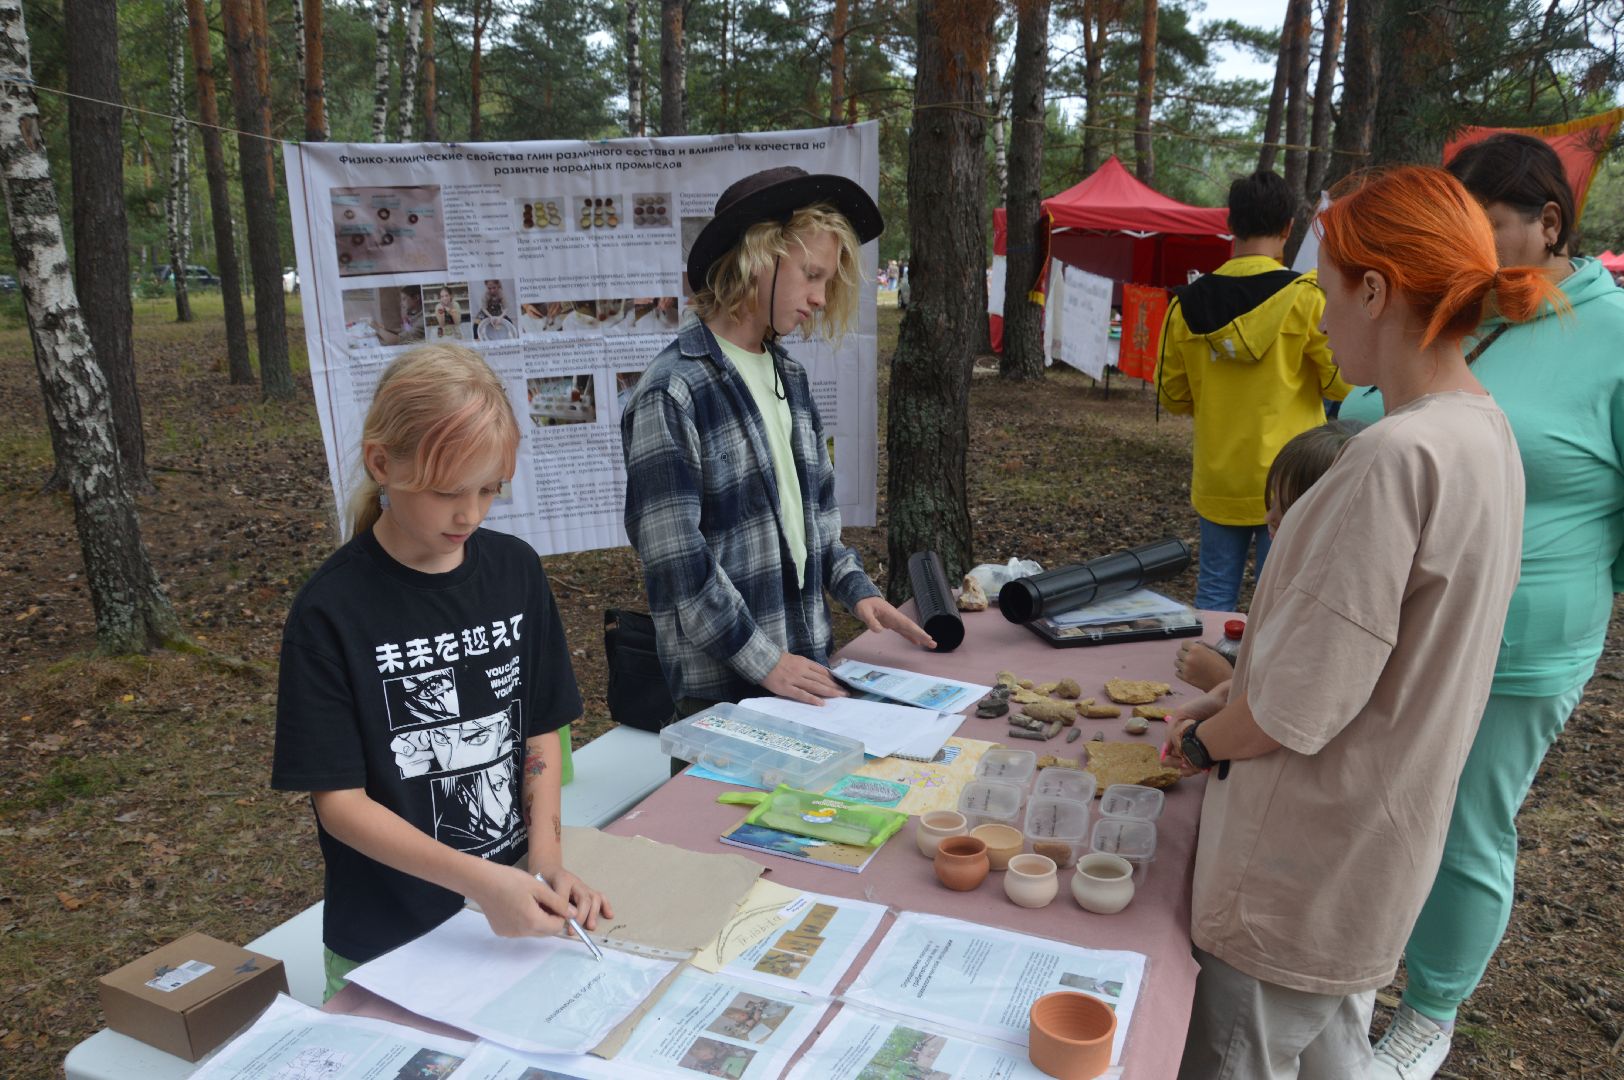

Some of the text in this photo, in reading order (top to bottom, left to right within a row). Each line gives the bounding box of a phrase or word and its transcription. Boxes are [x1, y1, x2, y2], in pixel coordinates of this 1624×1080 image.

[338, 151, 464, 165] Физико-химические
[466, 150, 524, 161] свойства
[526, 151, 553, 161] глин
[556, 147, 622, 161] различного
[625, 147, 675, 157] состава
[688, 143, 735, 155] влияние
[737, 142, 751, 151] их
[754, 141, 809, 152] качества
[812, 141, 826, 150] на
[494, 160, 682, 176] развитие народных промыслов
[375, 613, 524, 674] 未来を越えて
[485, 665, 505, 678] YOU
